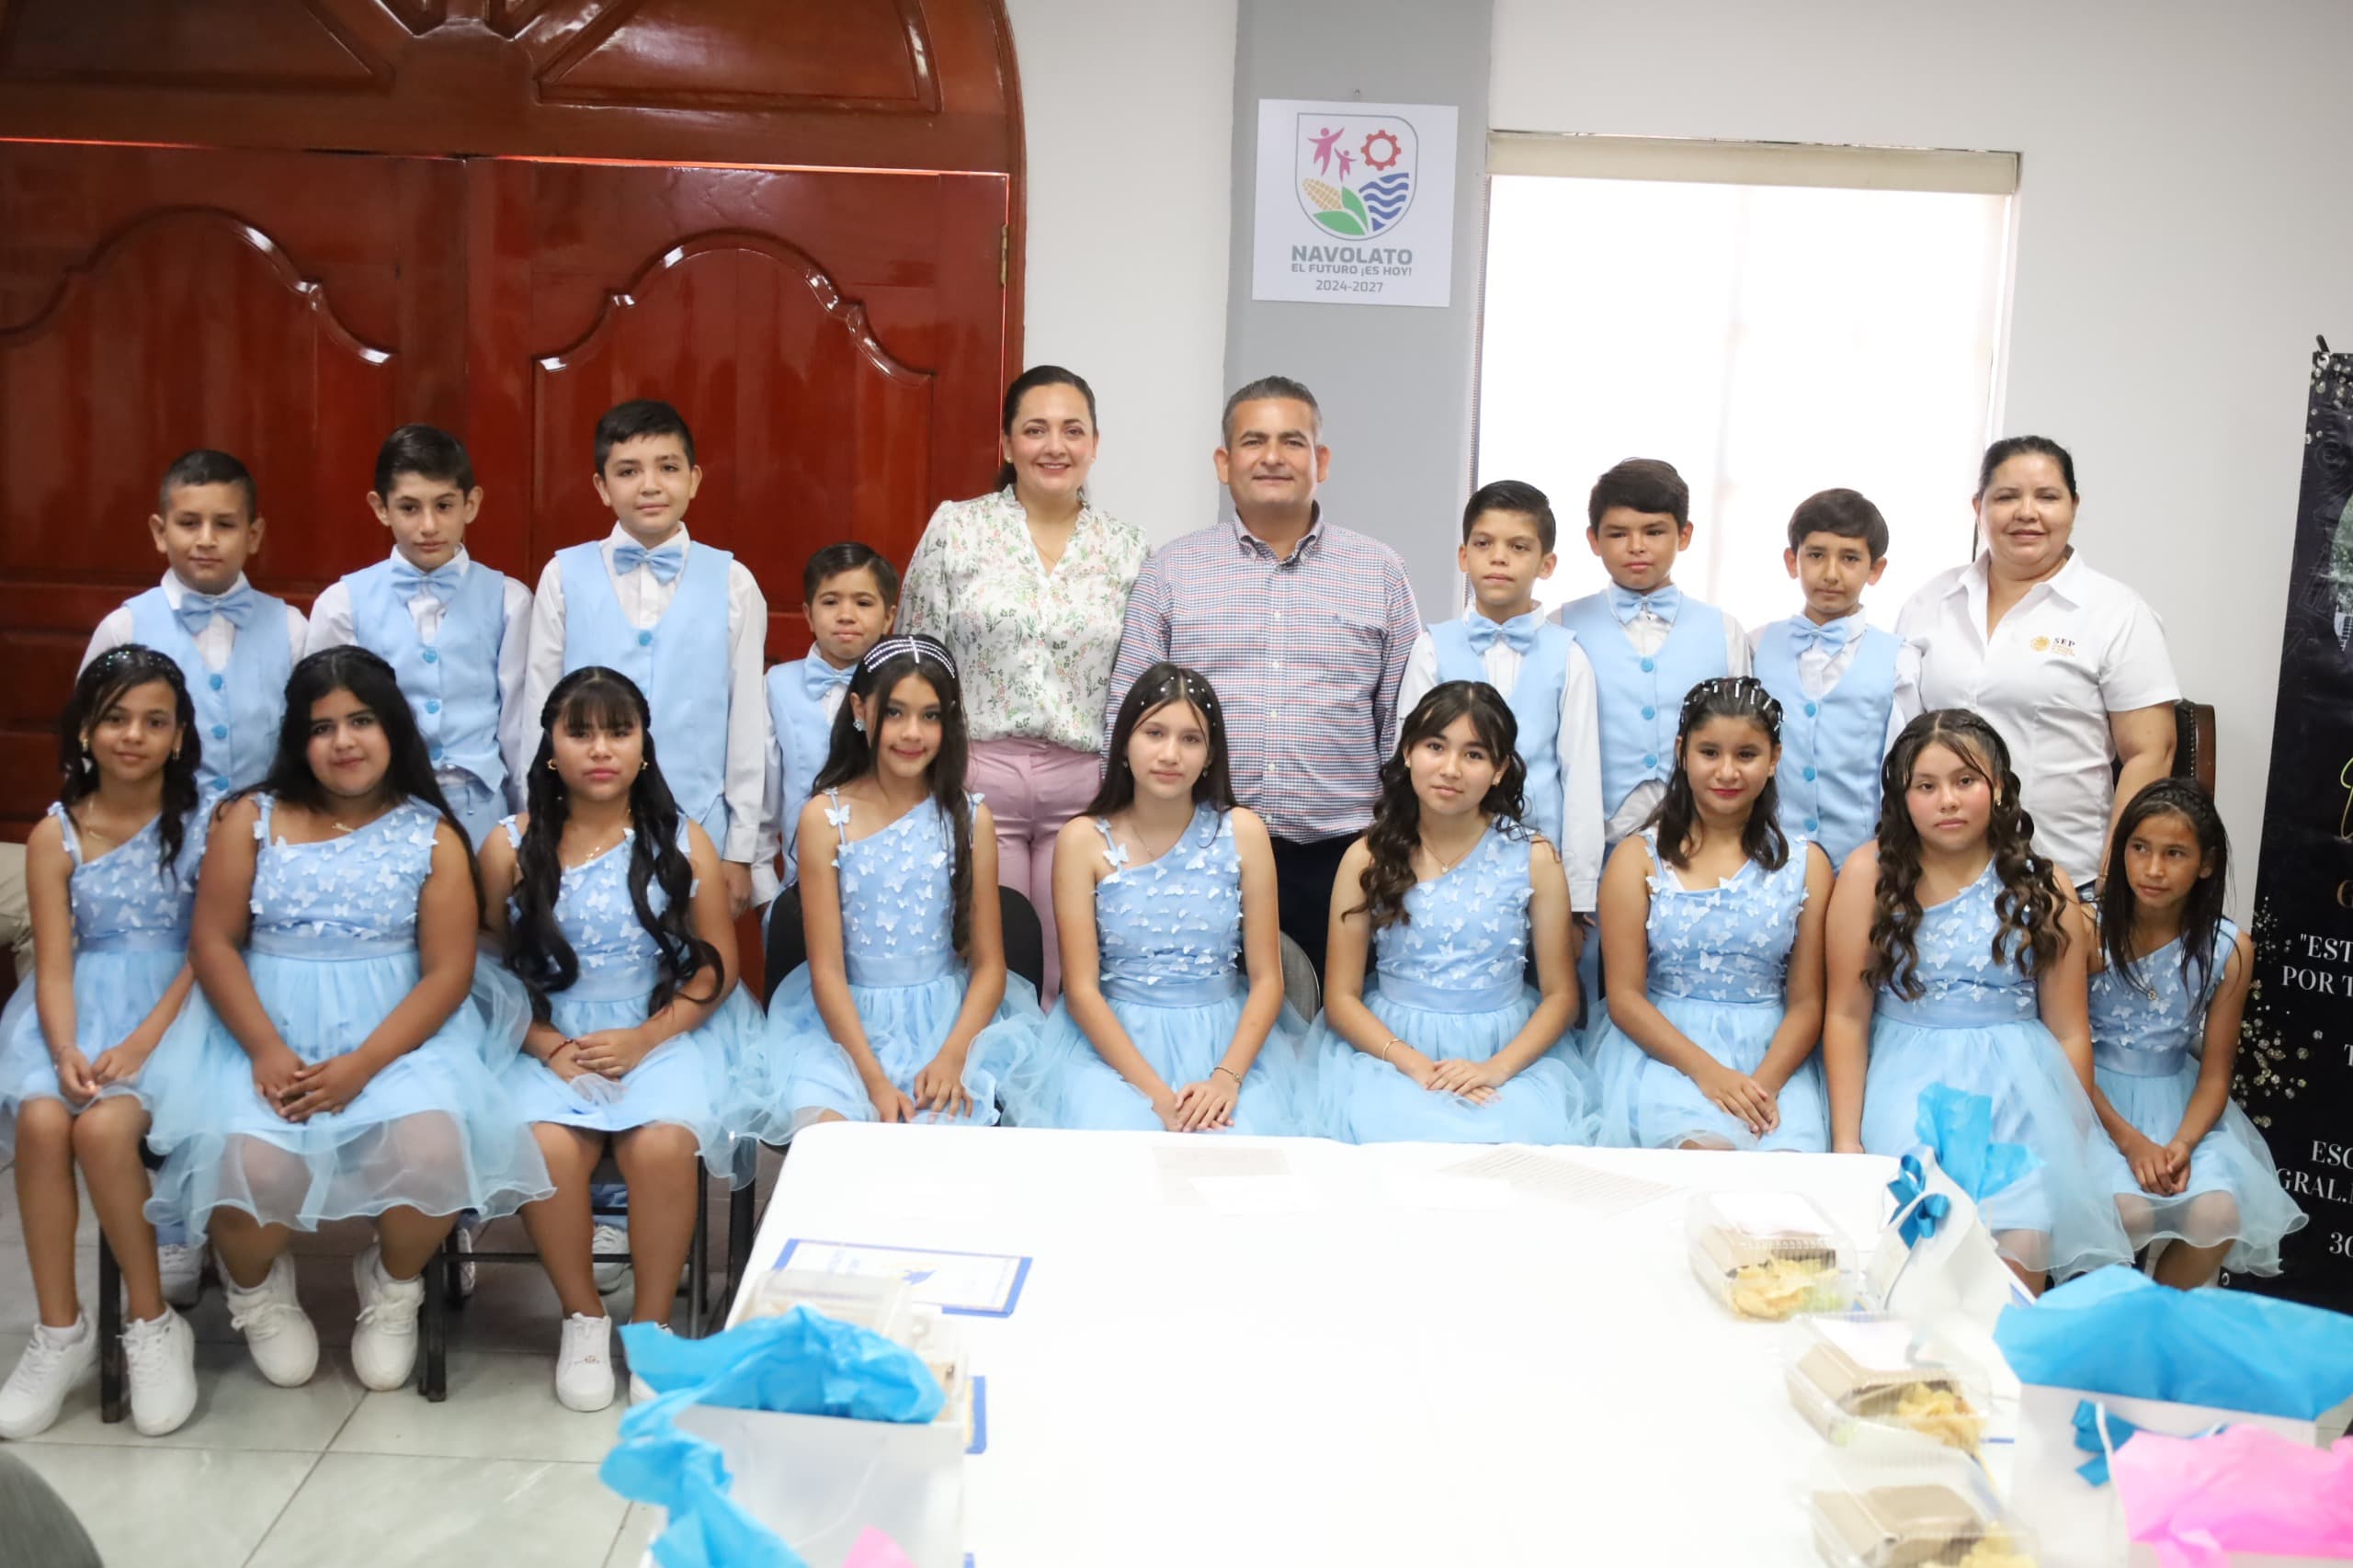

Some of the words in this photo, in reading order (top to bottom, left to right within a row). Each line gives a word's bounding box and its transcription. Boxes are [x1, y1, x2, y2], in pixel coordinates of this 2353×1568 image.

[1290, 244, 1413, 265] NAVOLATO
[1291, 263, 1306, 273] EL
[1309, 264, 1358, 275] FUTURO
[1360, 266, 1380, 276] ¡ES
[1383, 267, 1412, 277] HOY!
[1315, 279, 1383, 293] 2024-2027
[2281, 965, 2335, 994] POR
